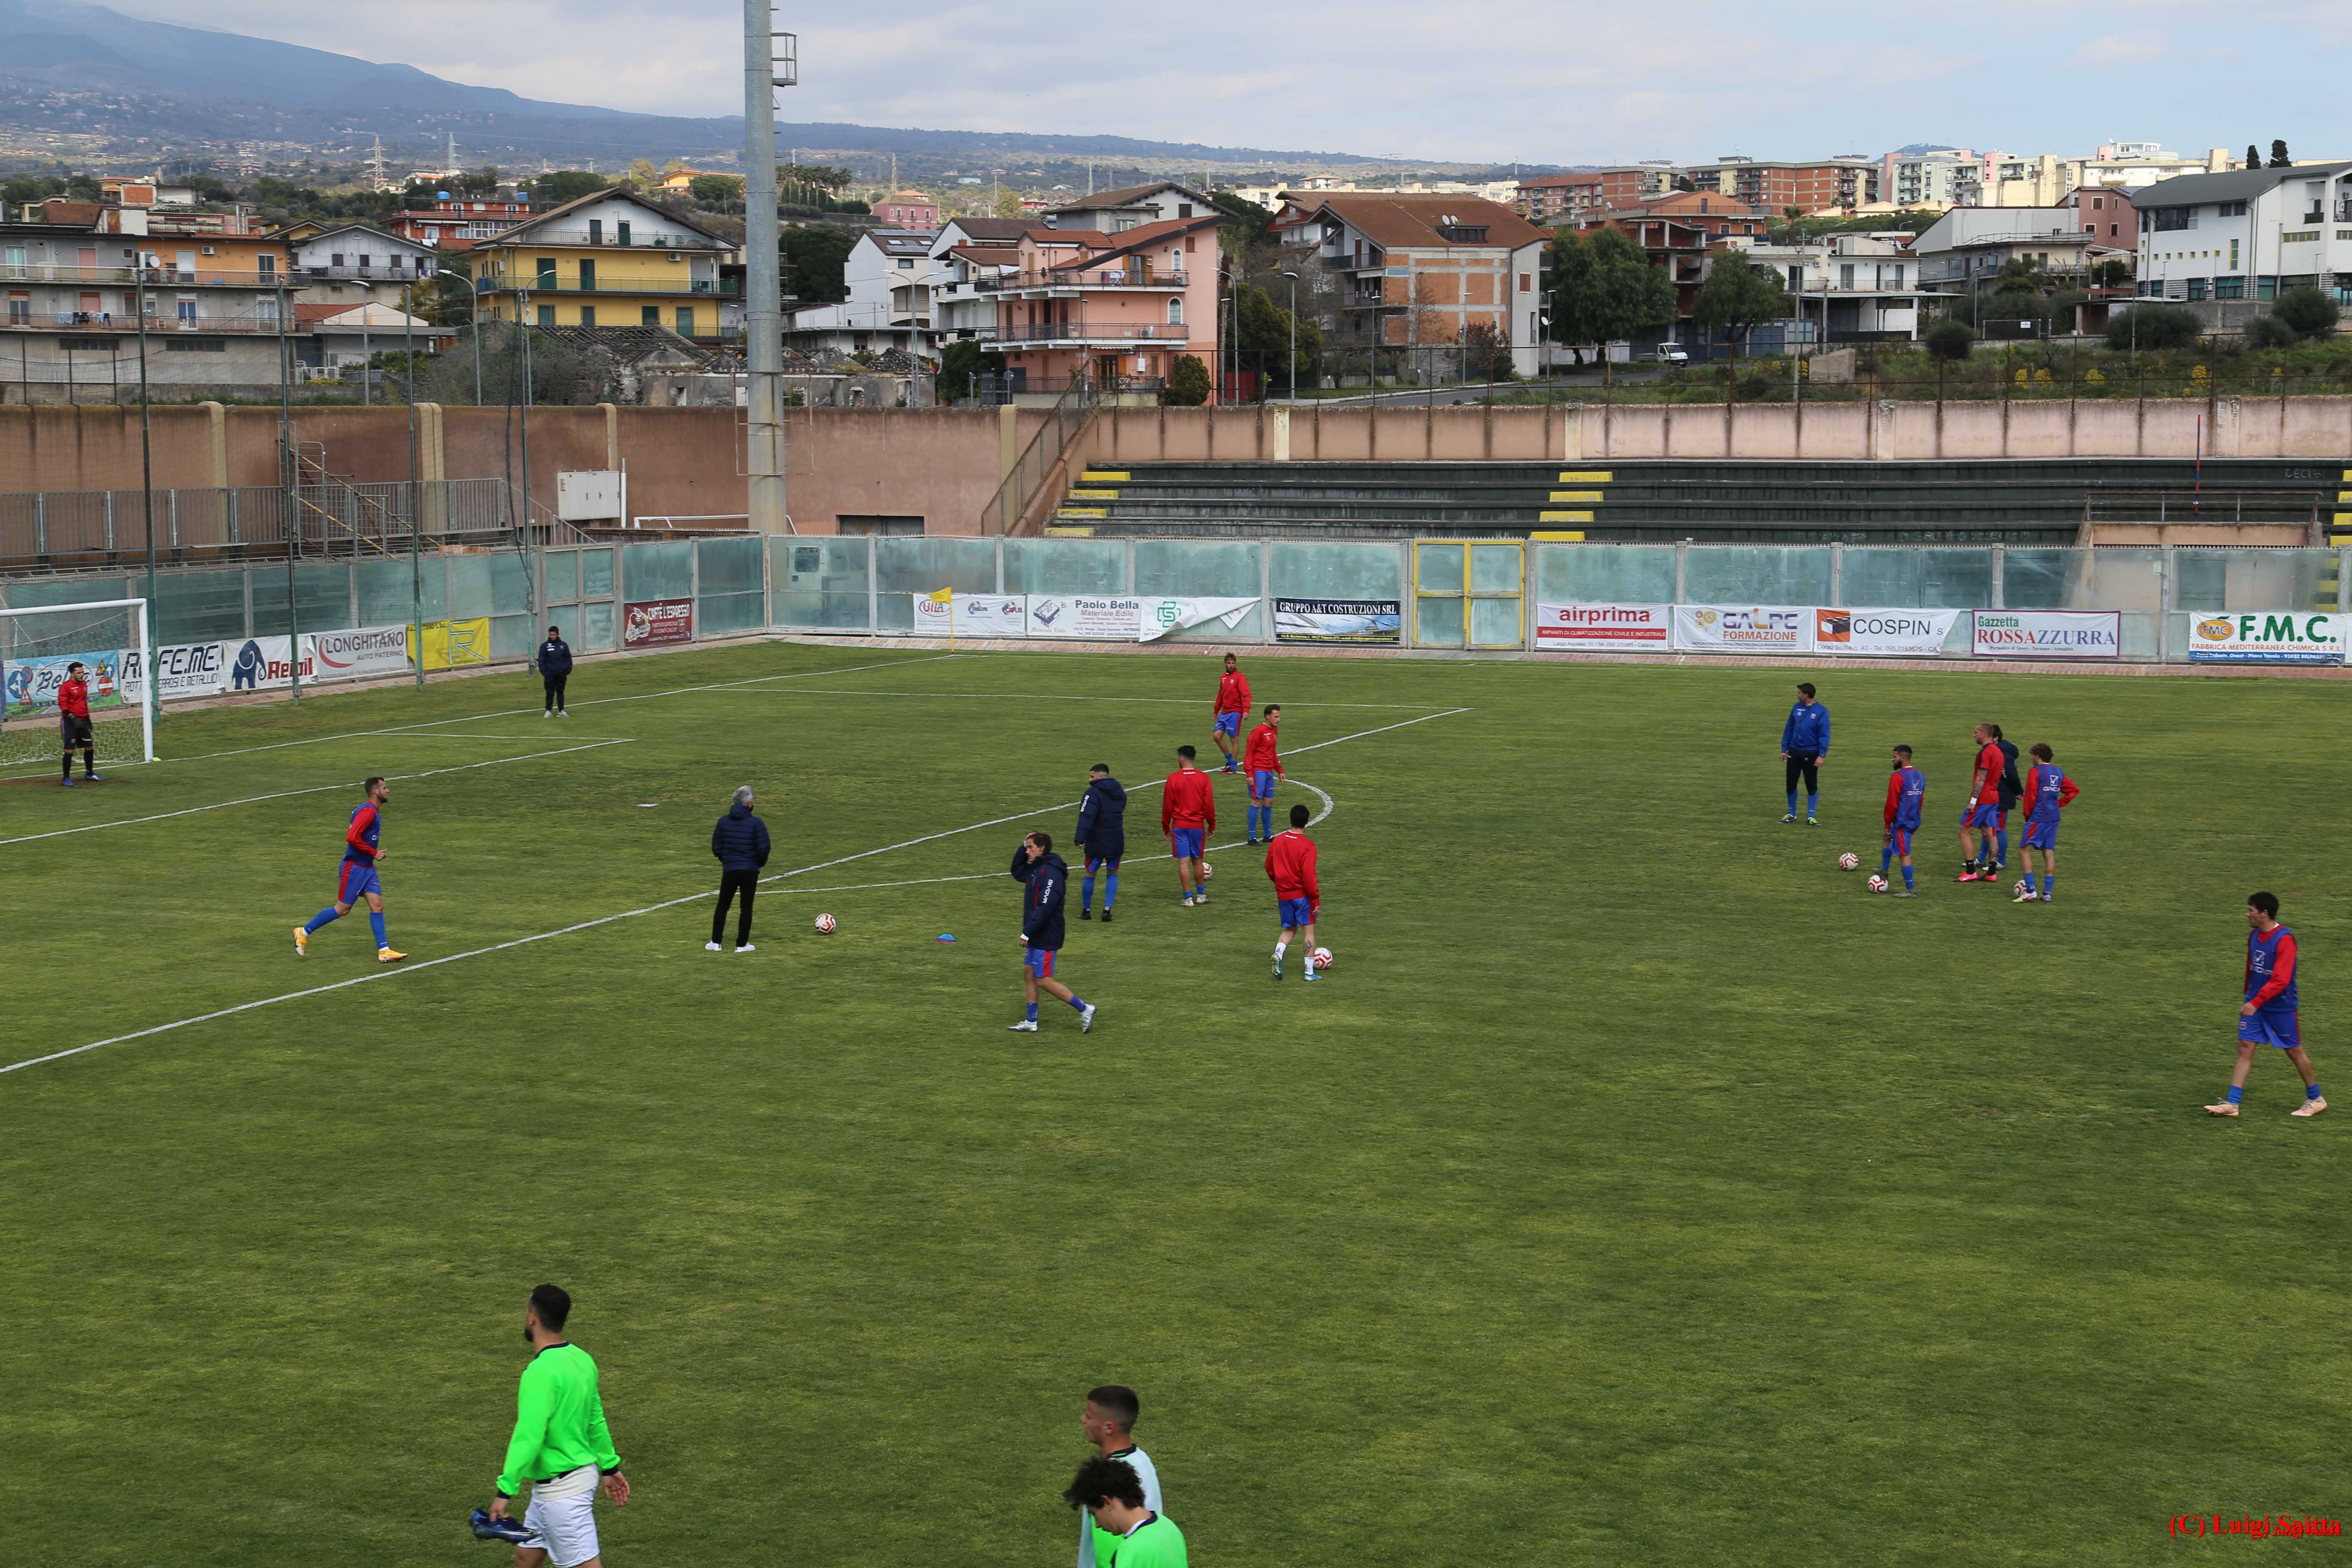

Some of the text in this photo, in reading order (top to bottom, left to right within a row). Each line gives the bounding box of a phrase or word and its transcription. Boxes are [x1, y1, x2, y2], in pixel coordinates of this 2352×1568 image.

[1075, 600, 1139, 609] Paolo Bella
[1280, 602, 1396, 614] GRUPPO A&T COSTRUZIONI SRL
[1559, 606, 1651, 625] airprima
[1978, 616, 2019, 627] Gazzetta
[1853, 619, 1930, 635] COSPIN
[2202, 625, 2228, 636] FMC
[2240, 615, 2337, 643] F.M.C.
[326, 631, 404, 654] LONGHITANO
[1723, 631, 1797, 640] FORMAZIONE
[1977, 629, 2116, 645] ROSSAZZURRA
